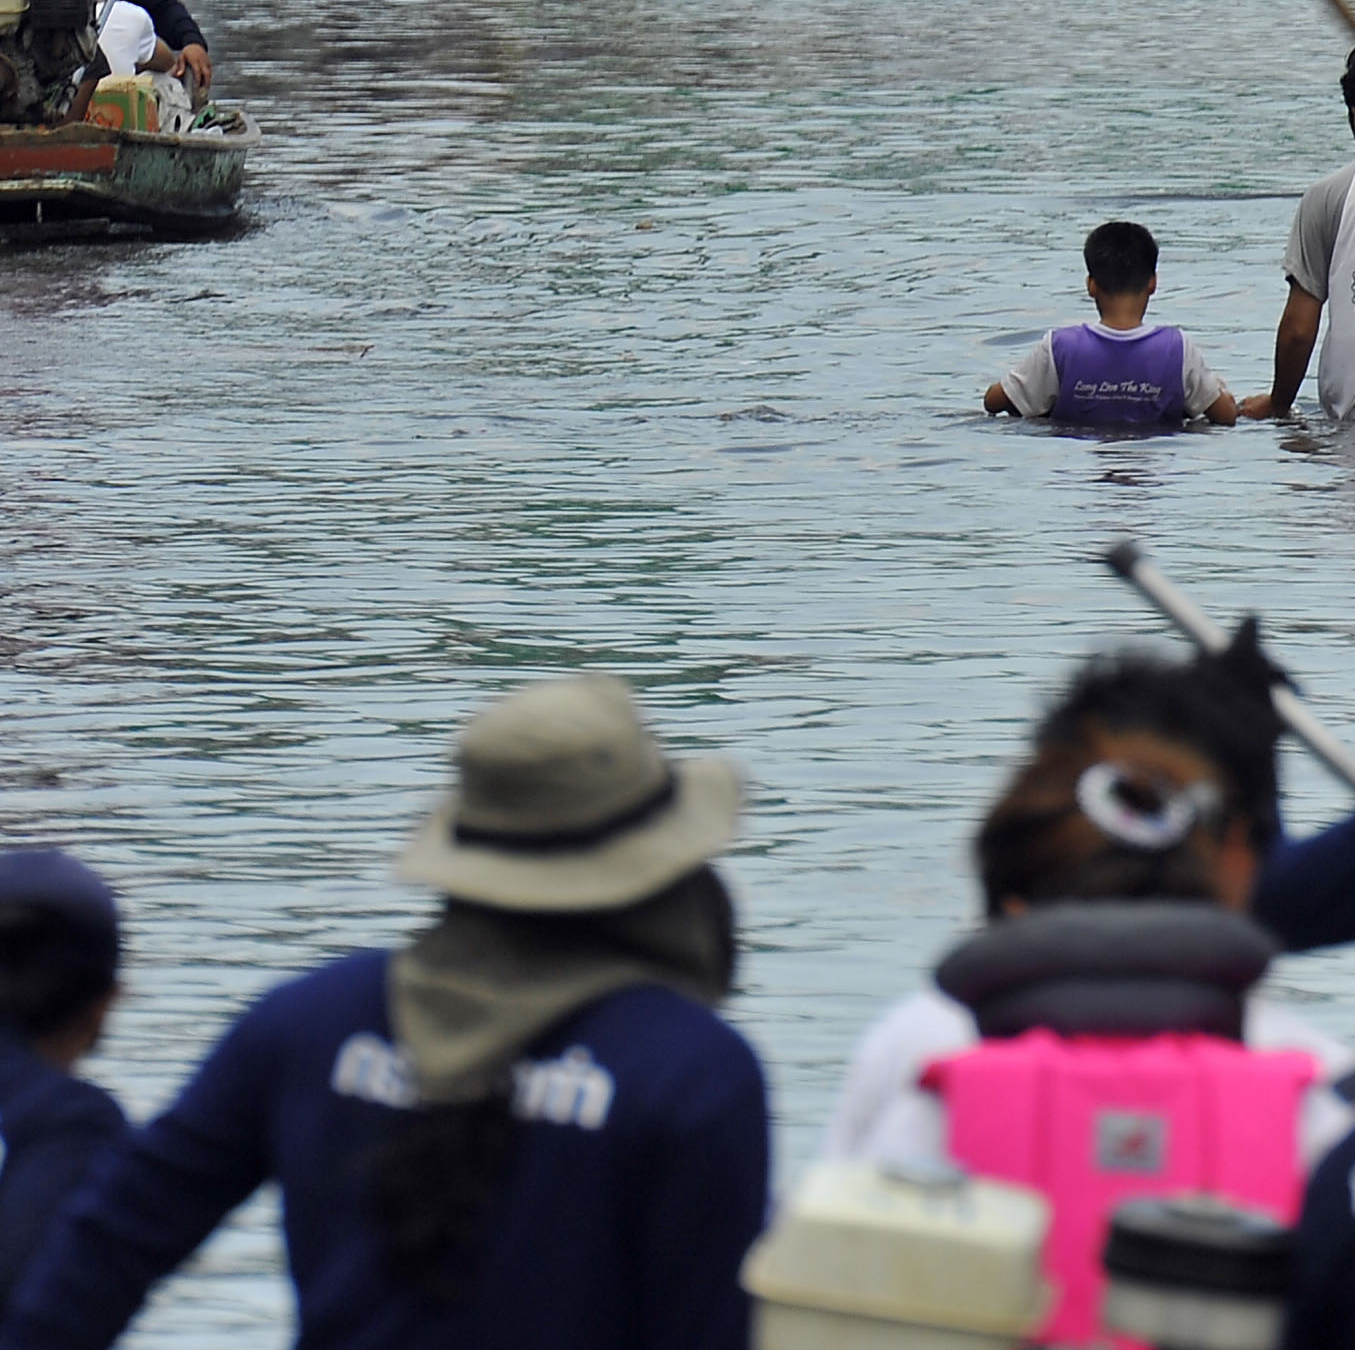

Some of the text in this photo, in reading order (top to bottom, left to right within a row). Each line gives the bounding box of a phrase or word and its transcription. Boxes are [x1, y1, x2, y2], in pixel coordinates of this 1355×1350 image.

[1073, 380, 1162, 397] Long Live The King
